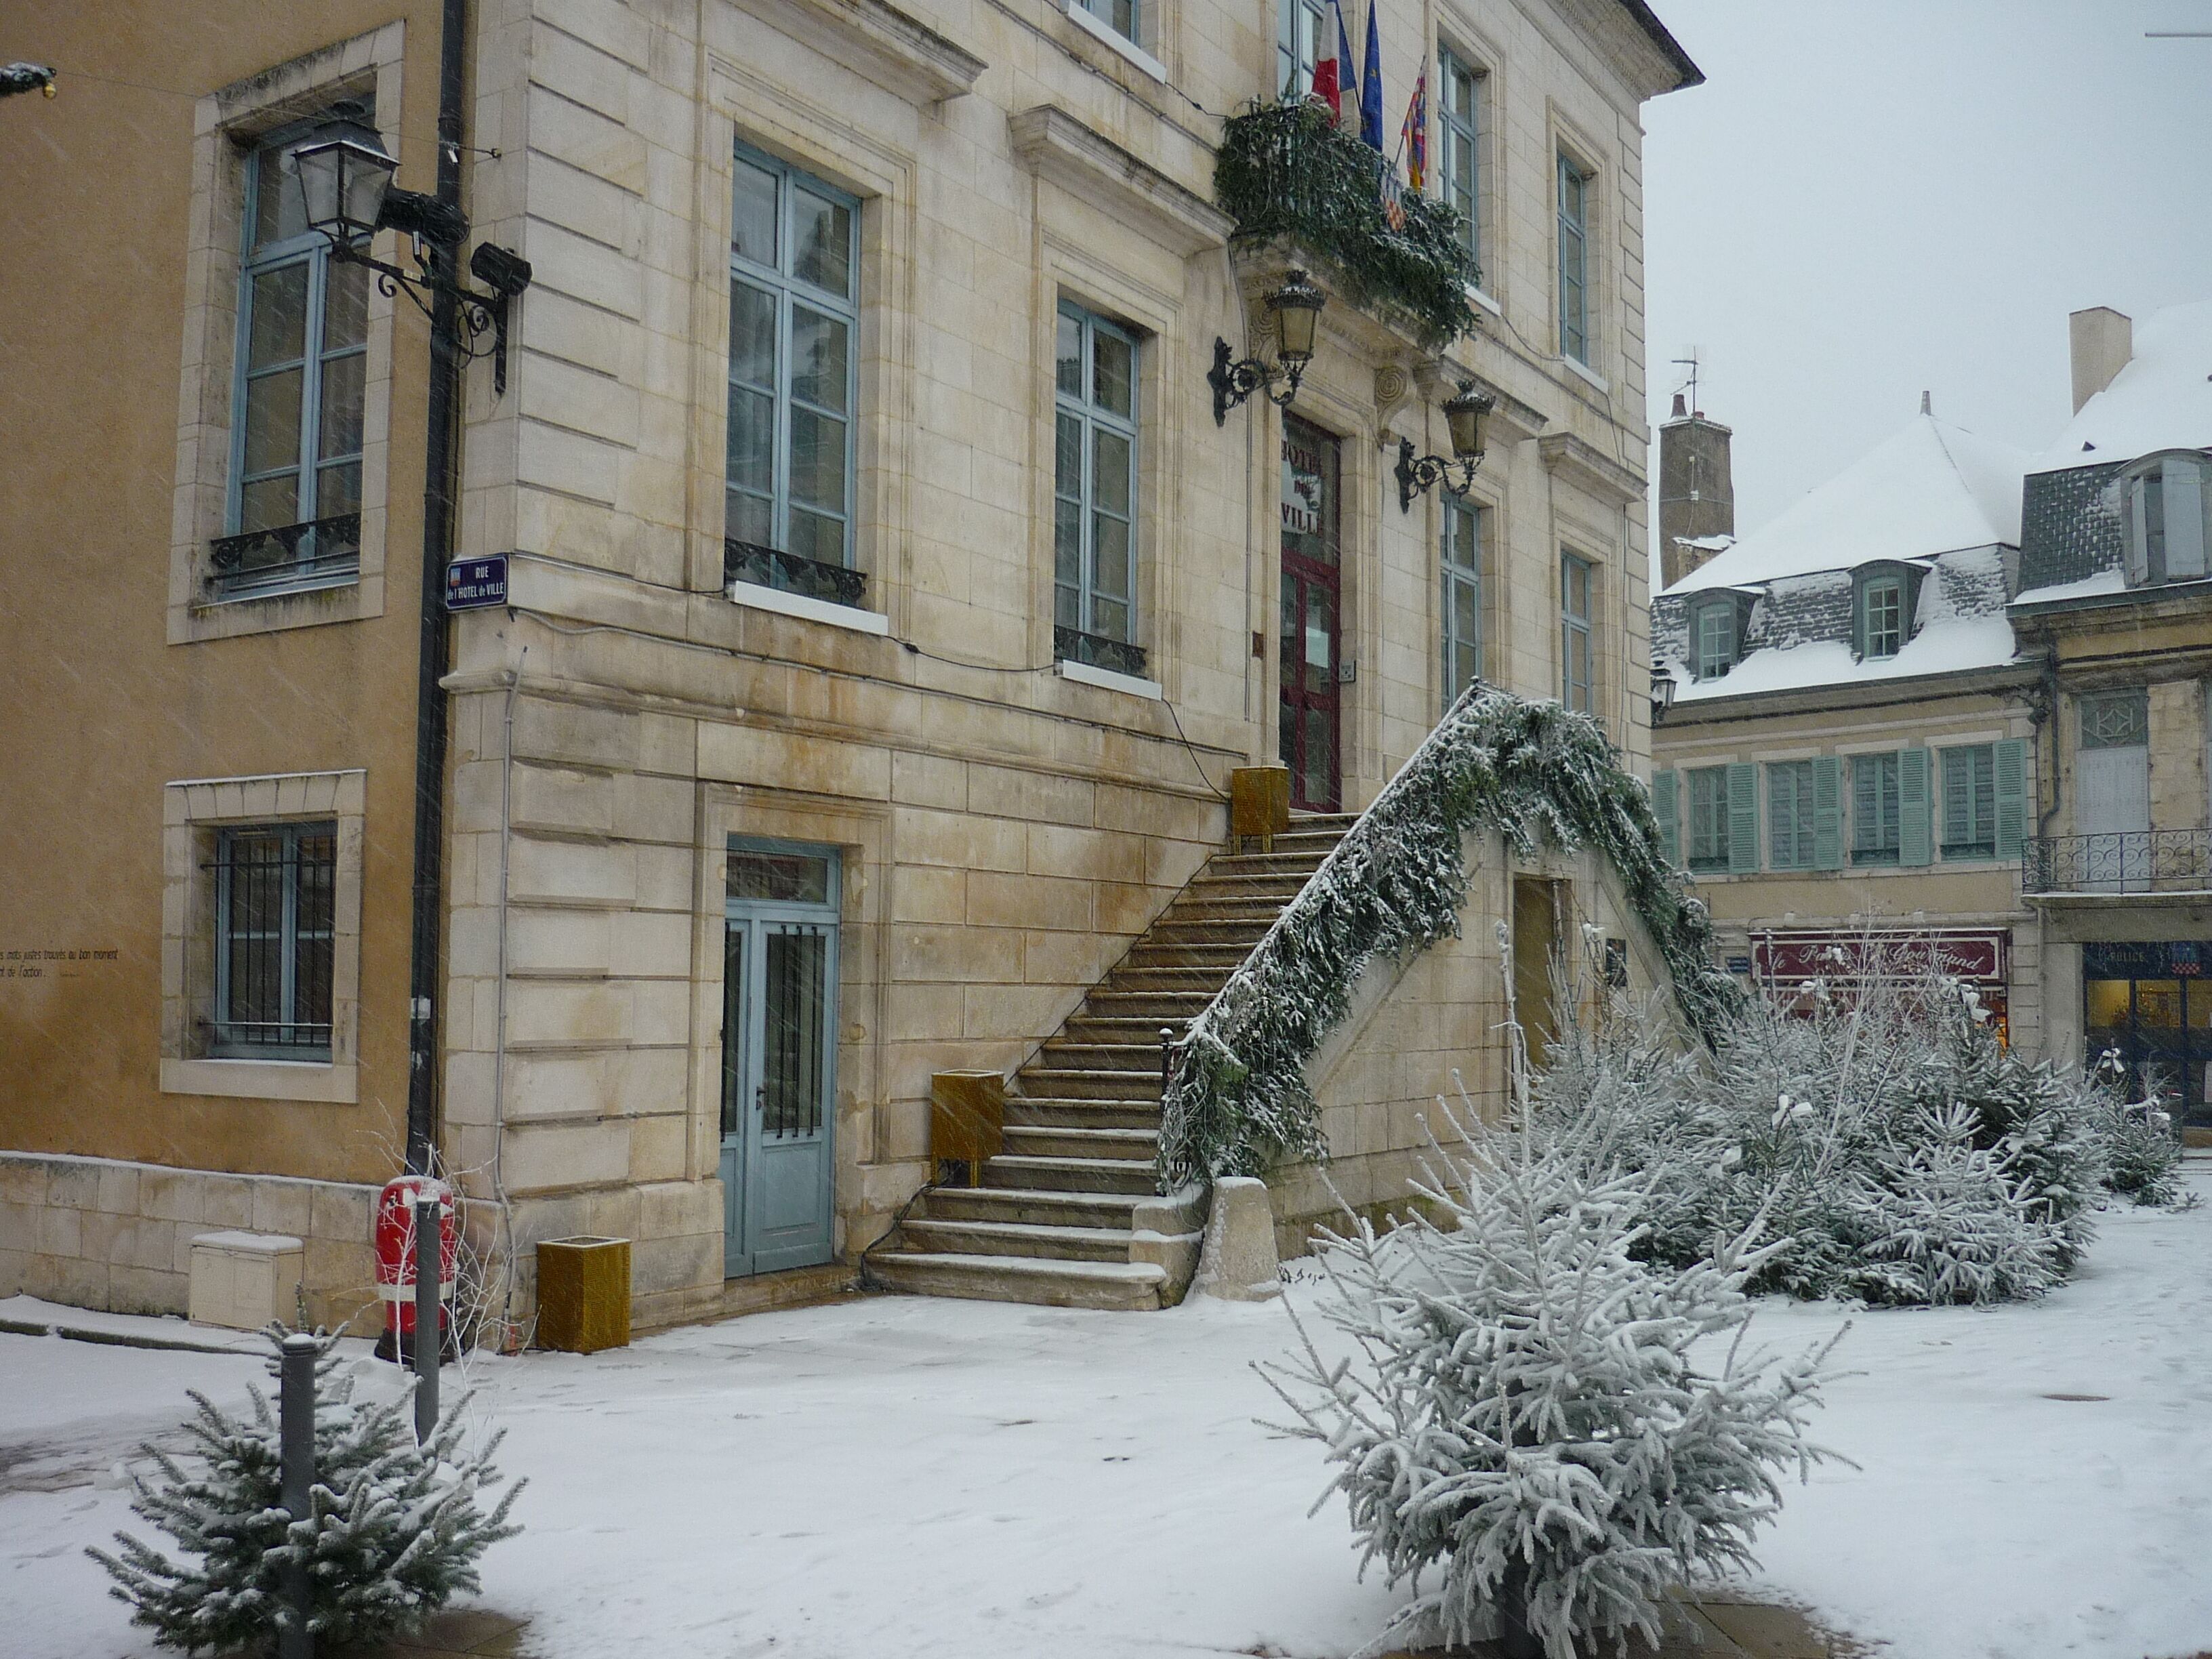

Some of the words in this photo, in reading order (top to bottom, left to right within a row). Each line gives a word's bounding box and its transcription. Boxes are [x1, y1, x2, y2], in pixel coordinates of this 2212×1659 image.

[476, 566, 489, 579] RUE
[447, 589, 453, 600] de
[479, 585, 486, 596] de
[487, 582, 504, 595] VILLE
[79, 949, 91, 960] bon
[94, 948, 119, 960] moment
[2110, 951, 2145, 962] POLICE
